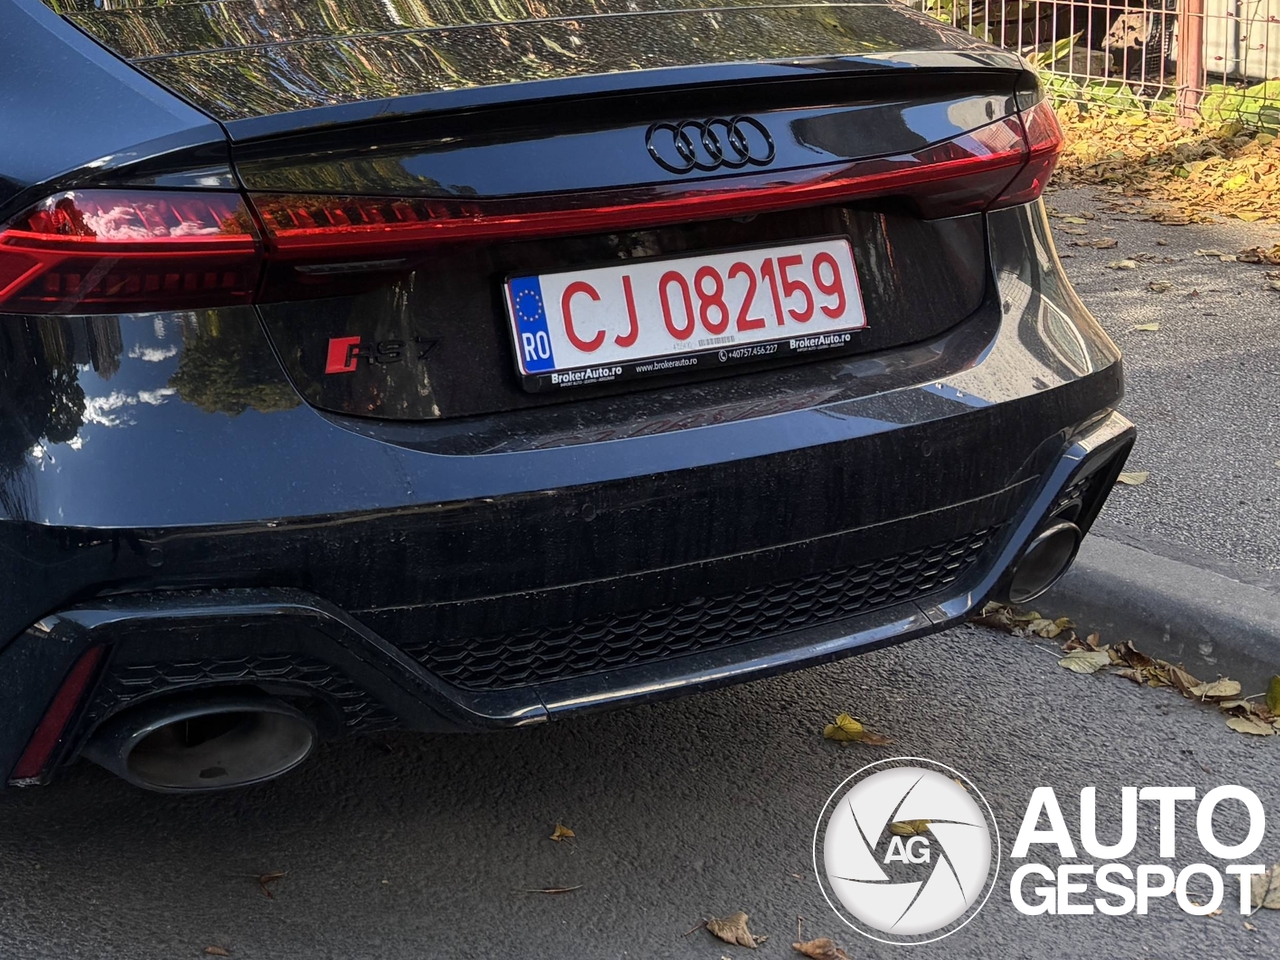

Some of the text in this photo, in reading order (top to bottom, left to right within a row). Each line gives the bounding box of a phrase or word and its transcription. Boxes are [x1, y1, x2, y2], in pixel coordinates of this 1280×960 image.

[561, 251, 848, 354] CJ 082159
[521, 330, 550, 361] RO
[789, 333, 851, 350] BrokerAuto.ro
[635, 357, 698, 373] www.brokerauto.ro
[551, 366, 622, 384] BrokerAuto.ro
